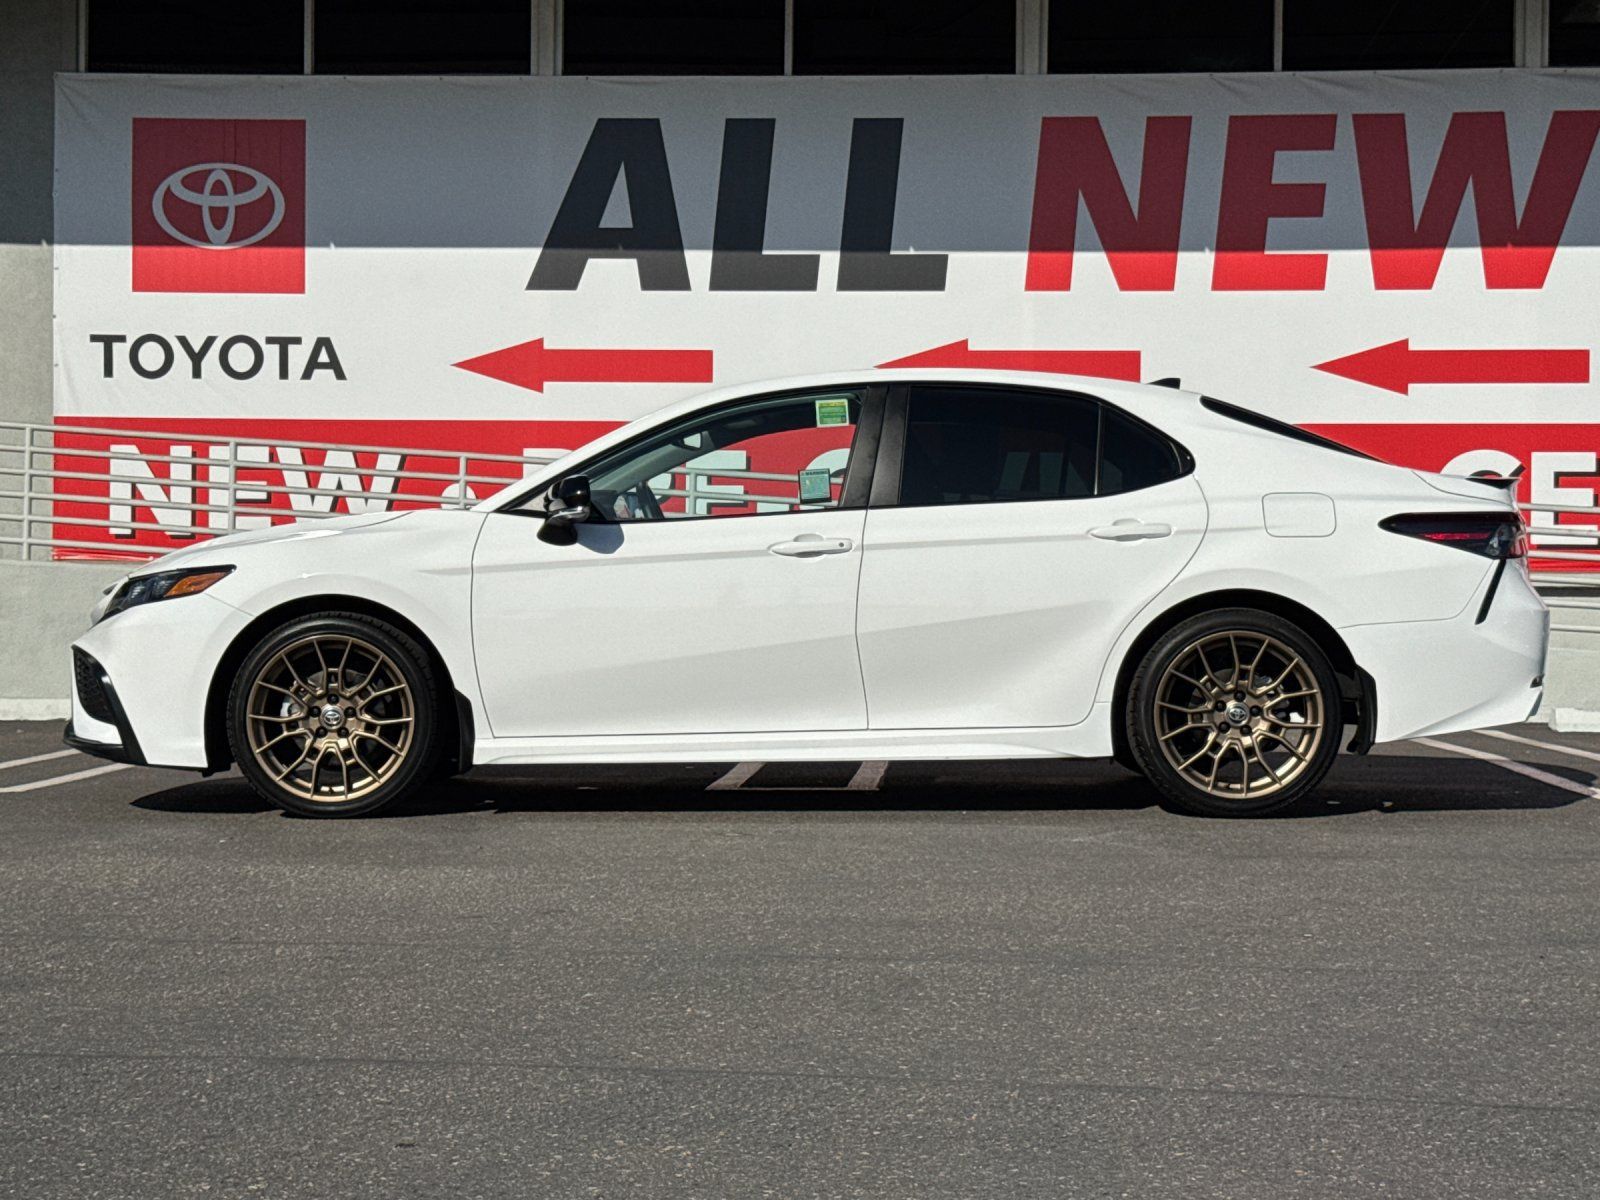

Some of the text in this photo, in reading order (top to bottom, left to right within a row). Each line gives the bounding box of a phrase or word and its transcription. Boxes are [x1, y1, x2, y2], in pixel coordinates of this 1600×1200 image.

[525, 110, 1600, 292] ALL NEW
[90, 333, 347, 381] TOYOTA
[109, 443, 402, 537] NEW
